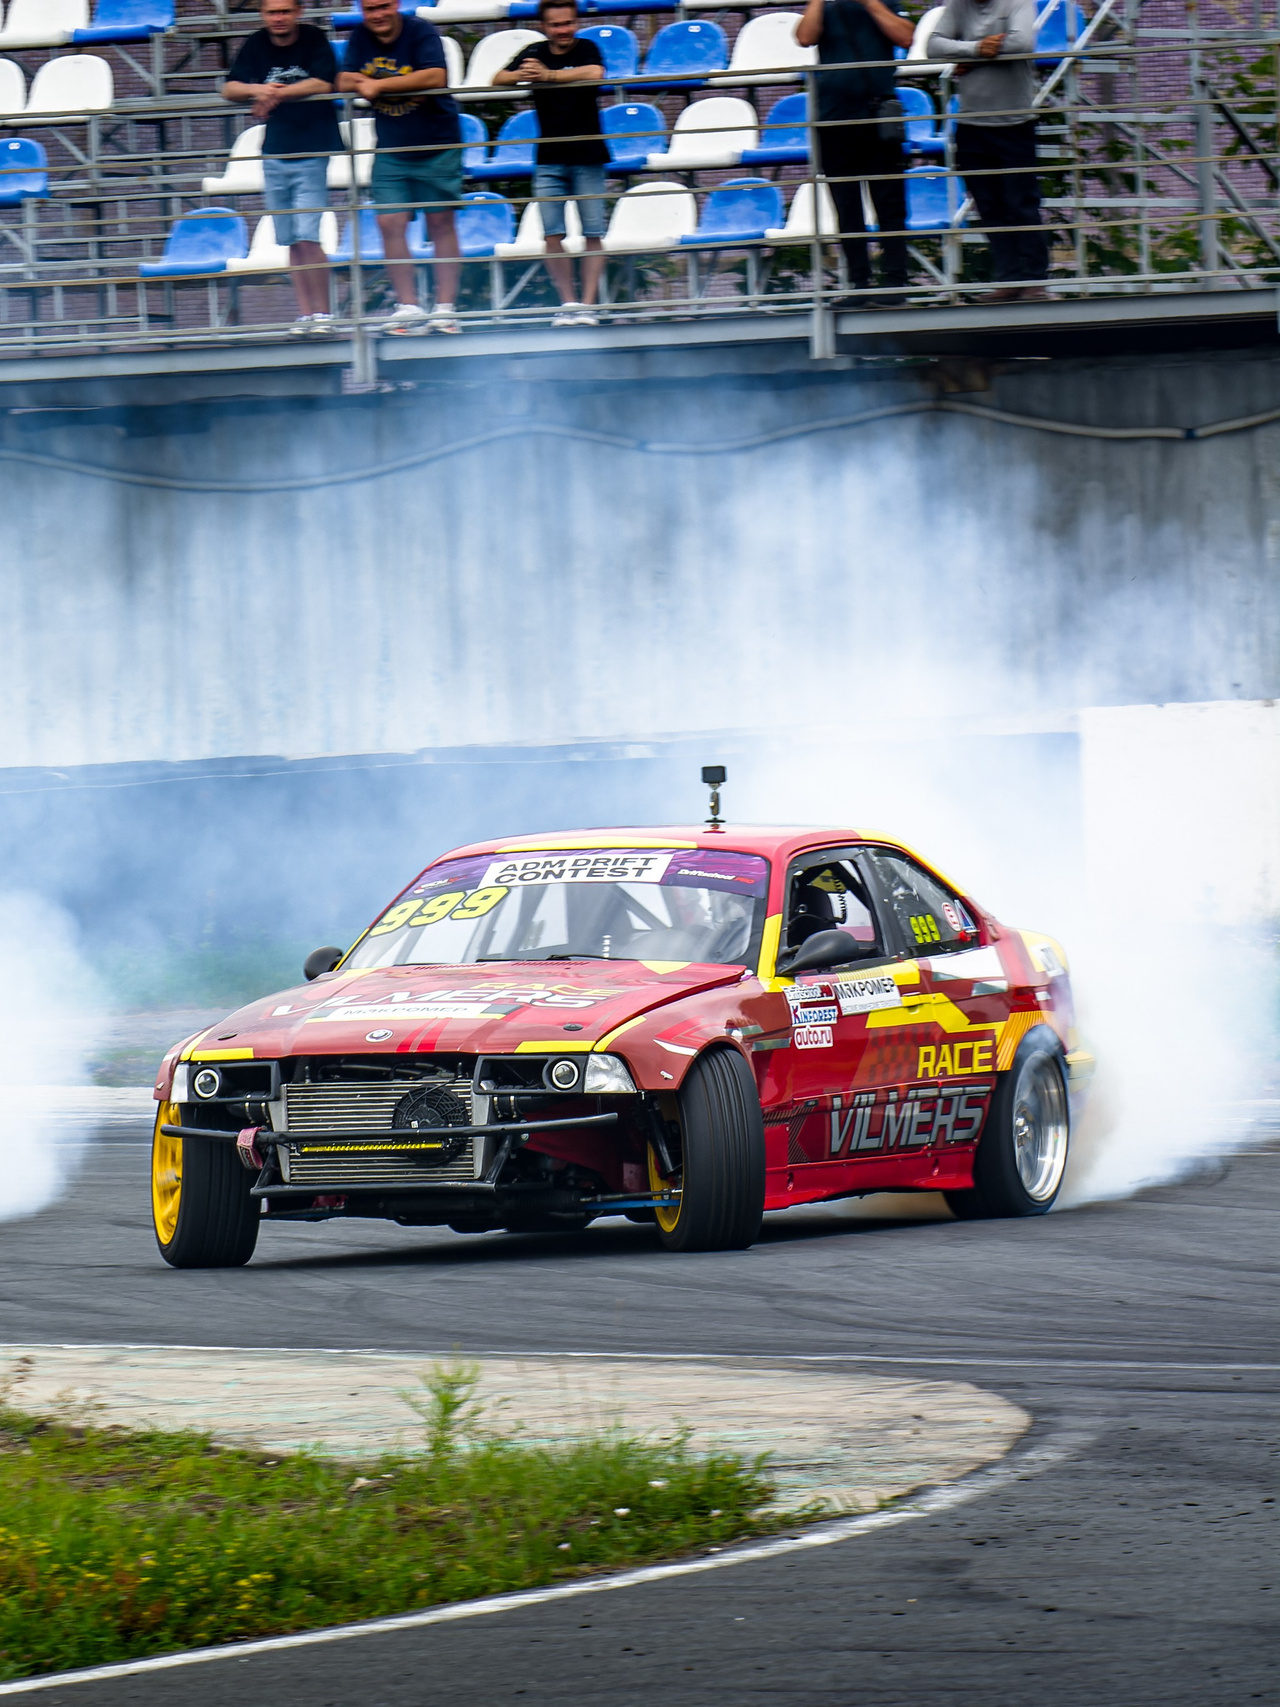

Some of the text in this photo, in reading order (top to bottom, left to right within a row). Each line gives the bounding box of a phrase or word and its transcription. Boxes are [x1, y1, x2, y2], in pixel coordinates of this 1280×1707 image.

[494, 867, 652, 884] CONTEST
[499, 857, 659, 873] ADM DRIFT
[369, 885, 511, 938] 999
[470, 982, 627, 997] RACE
[270, 989, 609, 1017] VILMERS
[796, 1028, 831, 1046] auto.ru
[916, 1039, 993, 1079] RACE
[830, 1085, 992, 1154] VILMERS
